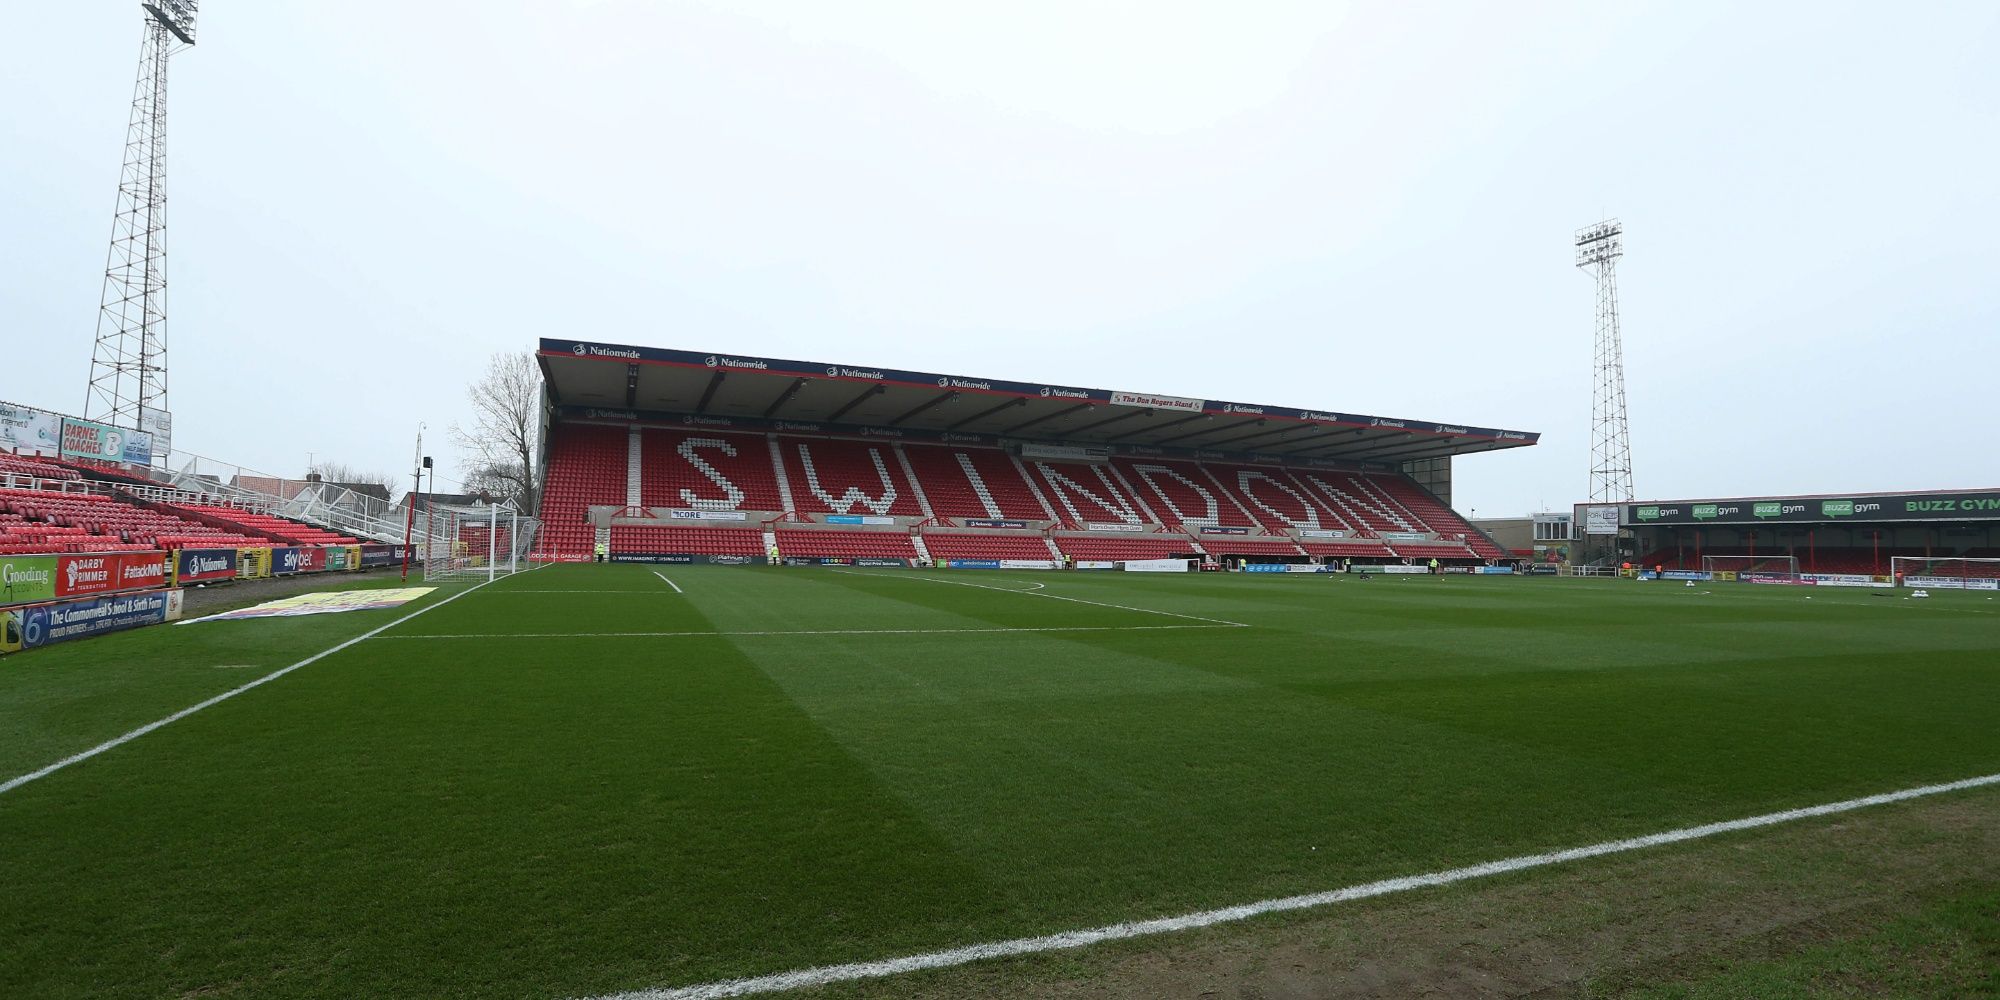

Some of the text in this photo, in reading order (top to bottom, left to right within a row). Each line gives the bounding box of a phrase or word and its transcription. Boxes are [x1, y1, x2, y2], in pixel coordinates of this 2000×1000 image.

[590, 346, 641, 359] Nationwide
[721, 358, 768, 370] Nationwide
[841, 368, 884, 380] Nationwide
[951, 379, 991, 391] Nationwide
[1052, 388, 1089, 400] Nationwide
[1122, 395, 1135, 404] The
[1174, 400, 1193, 409] Stand
[597, 408, 638, 421] Nationwide
[1233, 404, 1264, 415] Nationwide
[693, 415, 732, 426] Nationwide
[1309, 412, 1338, 422] Nationwide
[64, 423, 100, 441] BARNES
[63, 437, 103, 455] COACHES
[677, 438, 1428, 533] SWINDON
[1694, 506, 1739, 515] BUZZ gym
[1756, 504, 1804, 514] BUZZ gym
[1855, 503, 1880, 513] gym
[1907, 500, 1956, 512] BUZZ
[679, 511, 701, 519] CORE
[1660, 508, 1679, 517] gym
[78, 558, 104, 570] DARBY
[200, 556, 228, 571] Nationwide
[284, 550, 313, 568] sky bet
[3, 563, 48, 585] Gooding
[78, 570, 108, 583] RIMMER
[124, 563, 162, 579] #attackMND
[50, 597, 162, 626] The Commonweal School & Sixth Form
[50, 627, 65, 639] PROUD
[66, 624, 87, 636] PARTNERS
